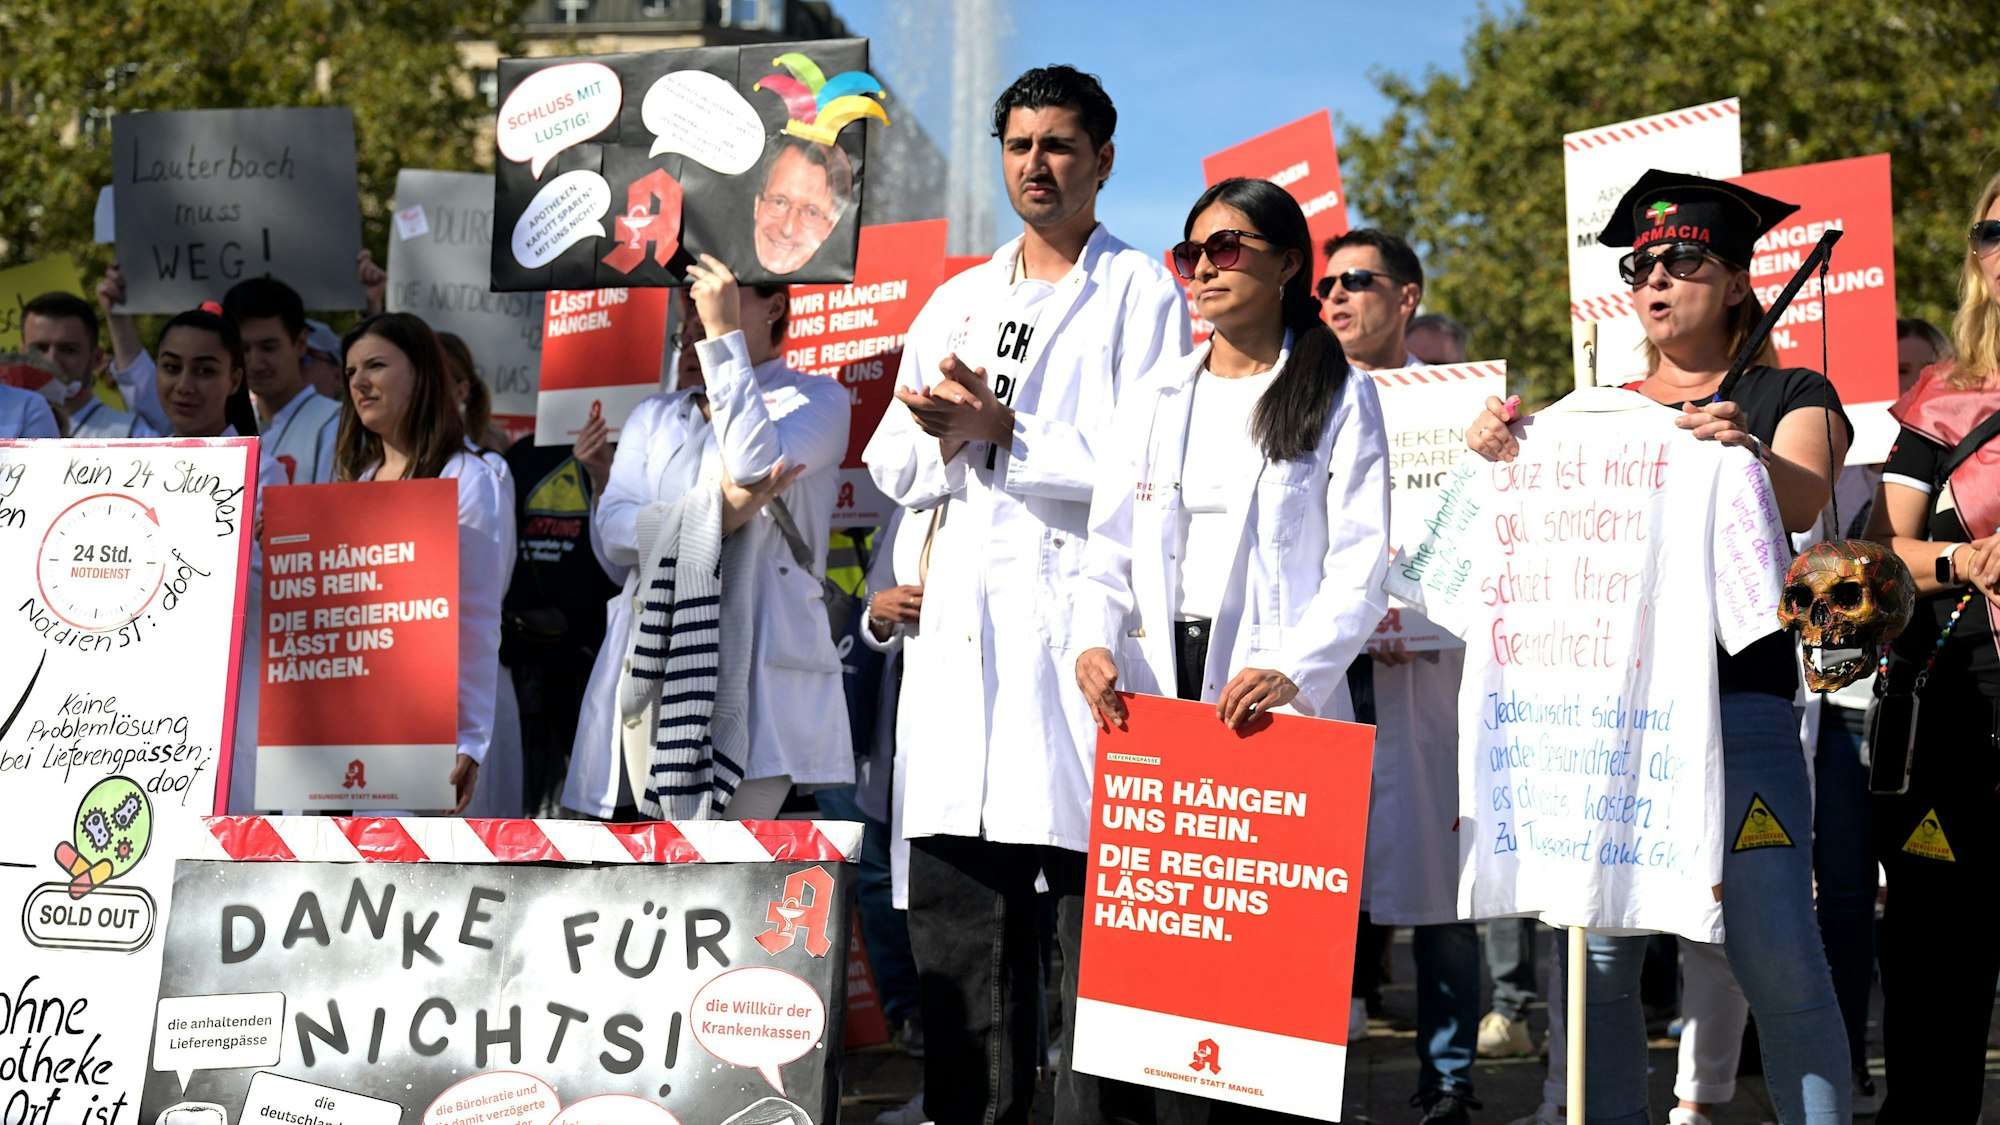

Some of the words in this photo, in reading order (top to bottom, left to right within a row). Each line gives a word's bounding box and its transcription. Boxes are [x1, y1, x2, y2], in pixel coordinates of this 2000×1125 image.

[507, 93, 574, 130] SCHLUSS
[577, 80, 602, 102] MIT
[535, 111, 590, 143] LUSTIG!
[131, 137, 296, 184] Lauterbach
[174, 202, 241, 226] muss
[529, 184, 577, 229] APOTHEKEN
[525, 218, 558, 249] KAPUTT
[534, 242, 550, 258] MIT
[551, 227, 569, 244] UNS
[550, 291, 595, 316] LÄSST
[598, 287, 628, 306] UNS
[790, 292, 824, 316] WIR
[828, 280, 907, 310] HÄNGEN
[548, 310, 611, 338] HÄNGEN.
[788, 315, 825, 339] UNS
[829, 308, 879, 332] REIN.
[786, 347, 817, 368] DIE
[845, 360, 884, 382] UNS
[1555, 442, 1587, 490] ist
[1604, 442, 1669, 490] nicht
[63, 457, 112, 485] Kein
[123, 459, 155, 488] 24
[163, 460, 245, 537] Stunden
[1544, 499, 1647, 542] sondern
[72, 544, 94, 562] 24
[100, 545, 132, 563] Std.
[269, 553, 313, 575] WIR
[319, 541, 415, 570] HÄNGEN
[70, 566, 131, 580] NOTDIENST
[270, 576, 317, 600] UNS
[322, 571, 382, 595] REIN.
[1574, 556, 1641, 604] Ihrer
[269, 611, 306, 634] DIE
[313, 598, 449, 630] REGIERUNG
[268, 633, 339, 659] LÄSST
[346, 628, 394, 651] UNS
[268, 656, 369, 683] HÄNGEN.
[57, 692, 117, 716] Keine
[1592, 696, 1626, 730] sich
[1633, 700, 1674, 731] und
[27, 711, 189, 745] Problemlösung
[0, 747, 34, 772] bei
[42, 739, 213, 784] Lieferengpässen:
[1109, 755, 1158, 764] LIEFERENGPÄSSE
[147, 758, 205, 807] doof
[1104, 774, 1163, 803] WIR
[1172, 778, 1307, 817] HÄNGEN
[1493, 785, 1511, 811] es
[1101, 804, 1165, 833] UNS
[1174, 812, 1258, 843] REIN.
[1099, 843, 1150, 871] DIE
[1160, 850, 1348, 893] REGIERUNG
[1096, 871, 1193, 906] LÄSST
[1203, 888, 1268, 916] UNS
[40, 905, 92, 927] SOLD
[97, 908, 139, 929] OUT
[222, 877, 506, 969] DANKE
[563, 901, 731, 979] FÜR
[1094, 900, 1233, 942] HÄNGEN.
[167, 1019, 188, 1031] die
[190, 1015, 272, 1030] anhaltenden
[706, 999, 728, 1013] die
[733, 1000, 783, 1016] Willkür
[787, 1004, 812, 1018] der
[170, 1035, 267, 1050] Lieferengpässe
[702, 1021, 811, 1040] Krankenkassen
[0, 1034, 113, 1085] otheke
[295, 997, 682, 1098] NICHTS!
[1144, 1067, 1198, 1083] GESUNDHEIT
[1200, 1078, 1225, 1089] STATT
[1228, 1083, 1265, 1097] MANGEL
[314, 1097, 335, 1110] die
[436, 1104, 453, 1116] die
[456, 1090, 514, 1112] Bürokratie
[516, 1084, 538, 1098] und
[452, 1114, 484, 1125] damit
[486, 1100, 545, 1120] verzögerte
